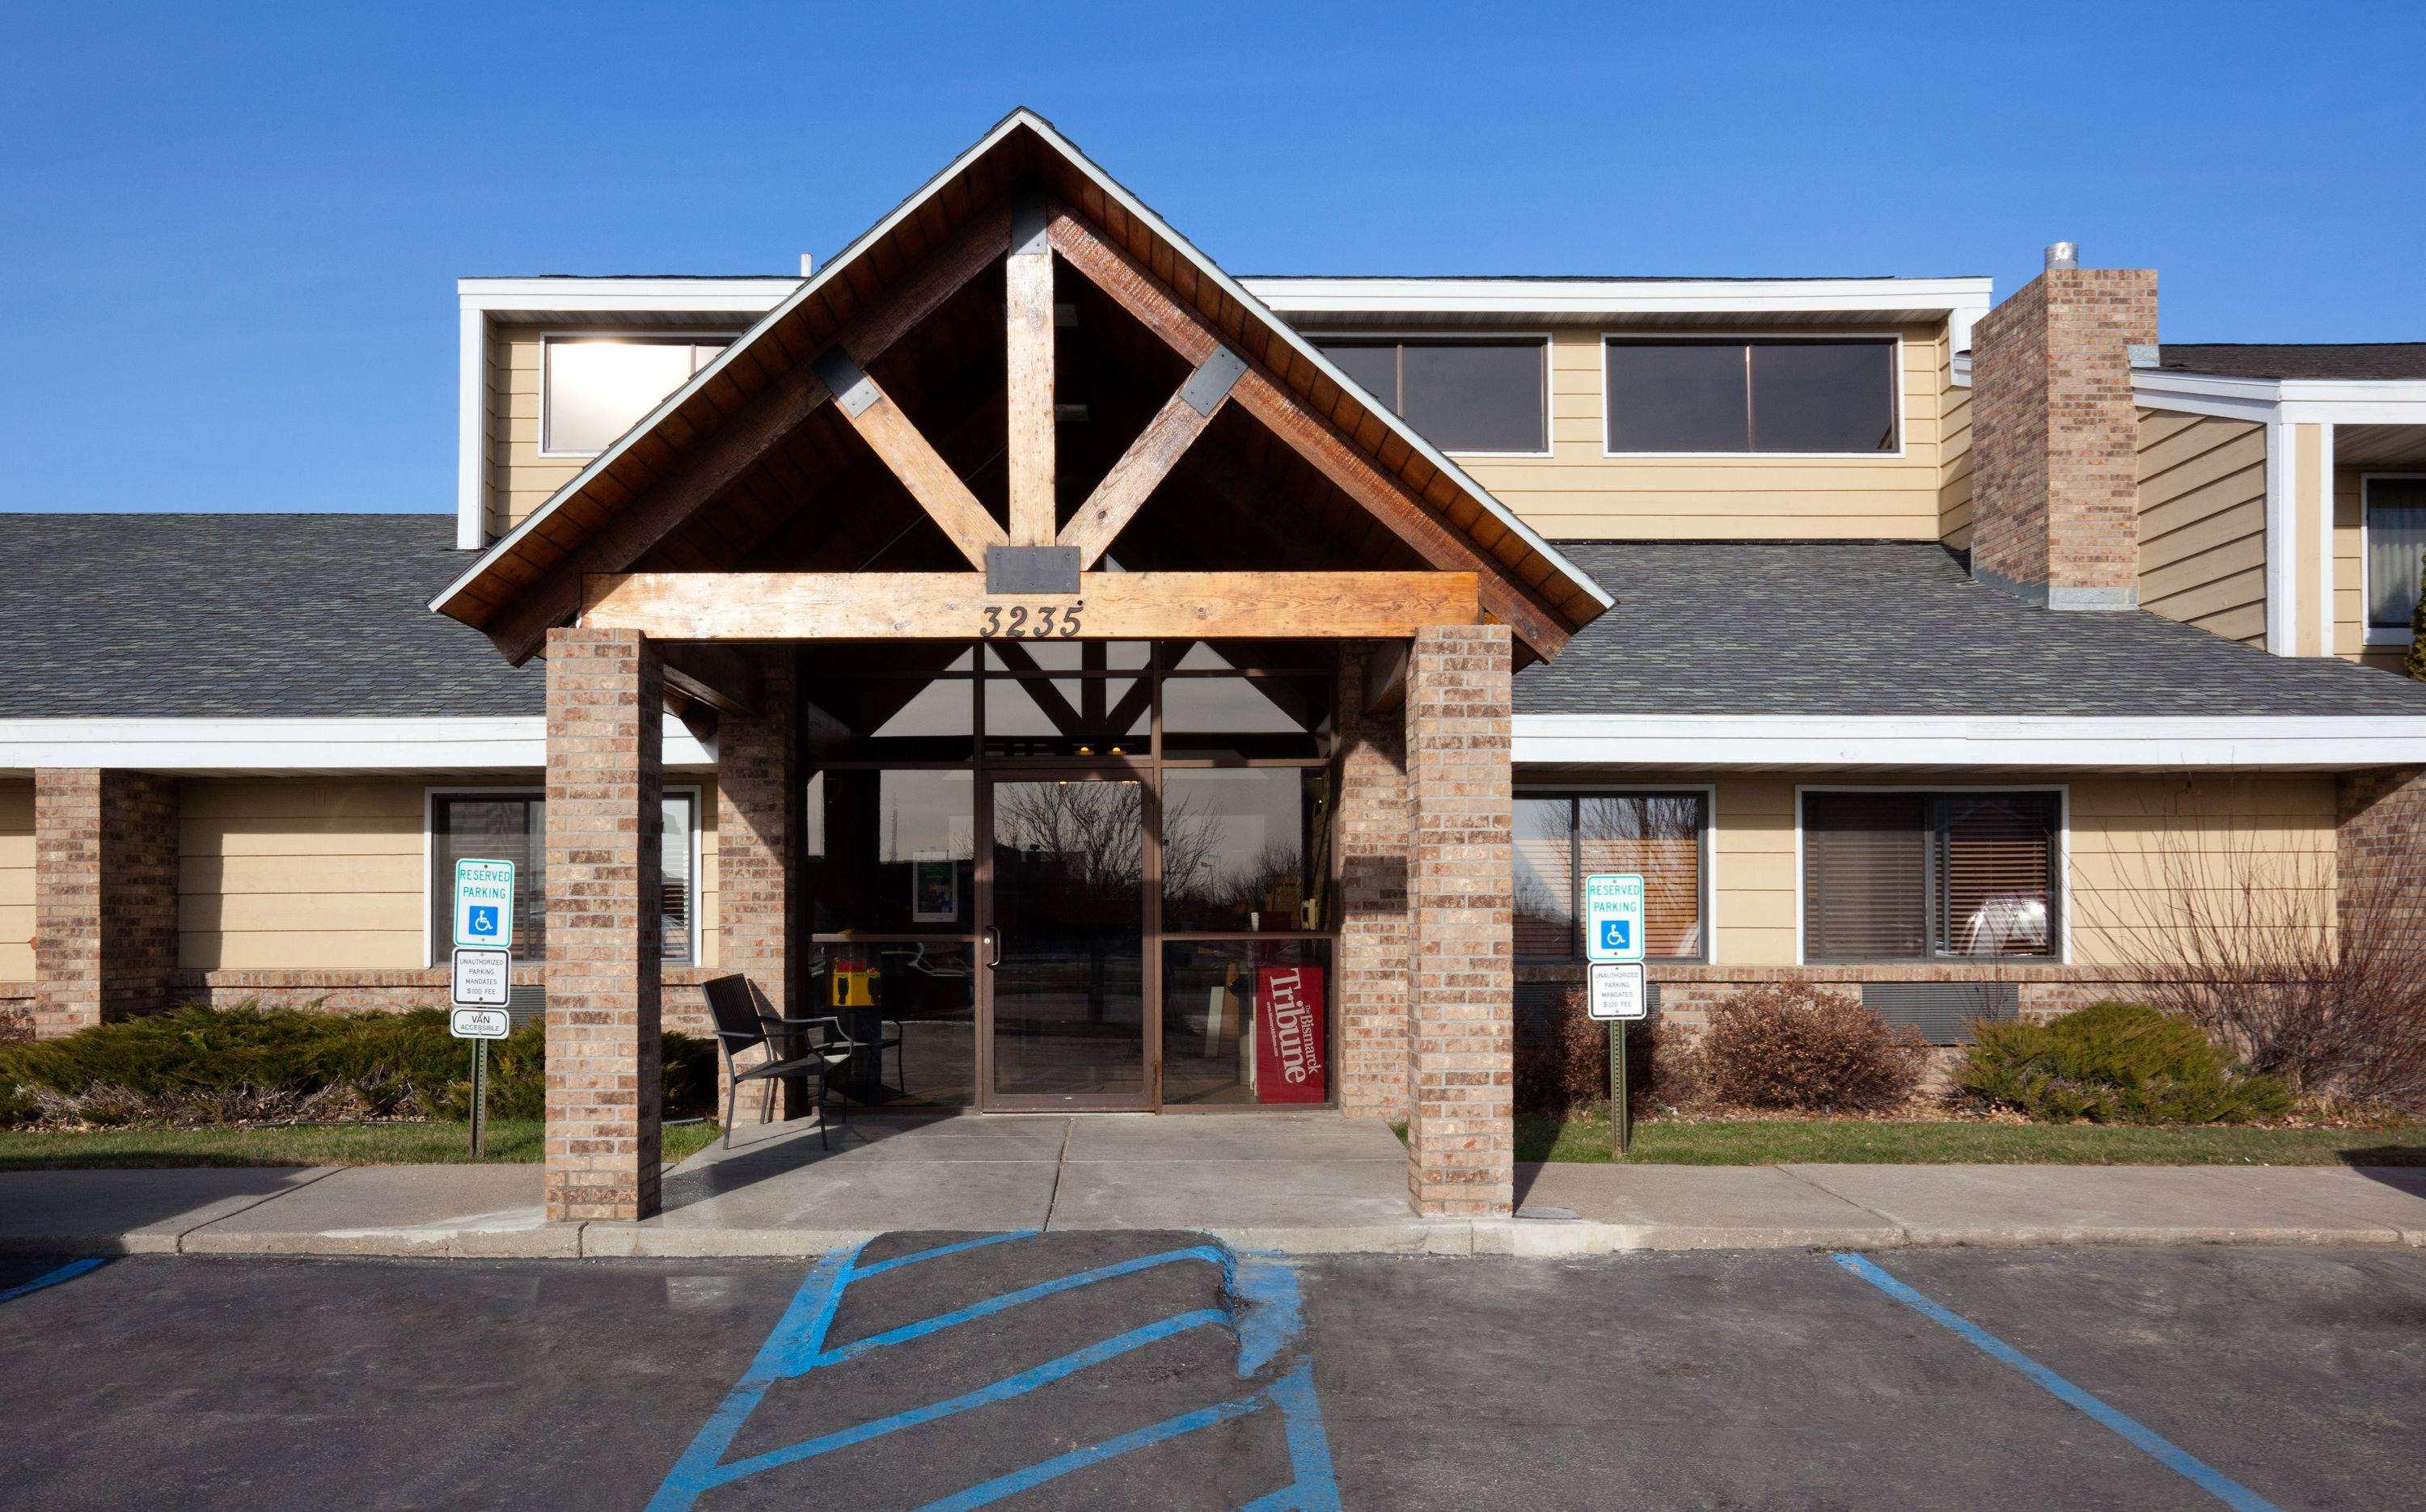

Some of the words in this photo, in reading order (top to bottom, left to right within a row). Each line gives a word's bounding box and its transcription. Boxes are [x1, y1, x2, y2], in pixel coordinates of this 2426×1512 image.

[980, 606, 1084, 637] 3235
[460, 869, 510, 882] RESERVED
[463, 886, 506, 899] PARKING
[1590, 885, 1640, 895] RESERVED
[1594, 902, 1637, 912] PARKING
[471, 1015, 490, 1024] VAN
[1270, 967, 1306, 1083] Tribune
[461, 1024, 500, 1032] ACCESSIBLE
[1300, 1016, 1321, 1075] Bismarck
